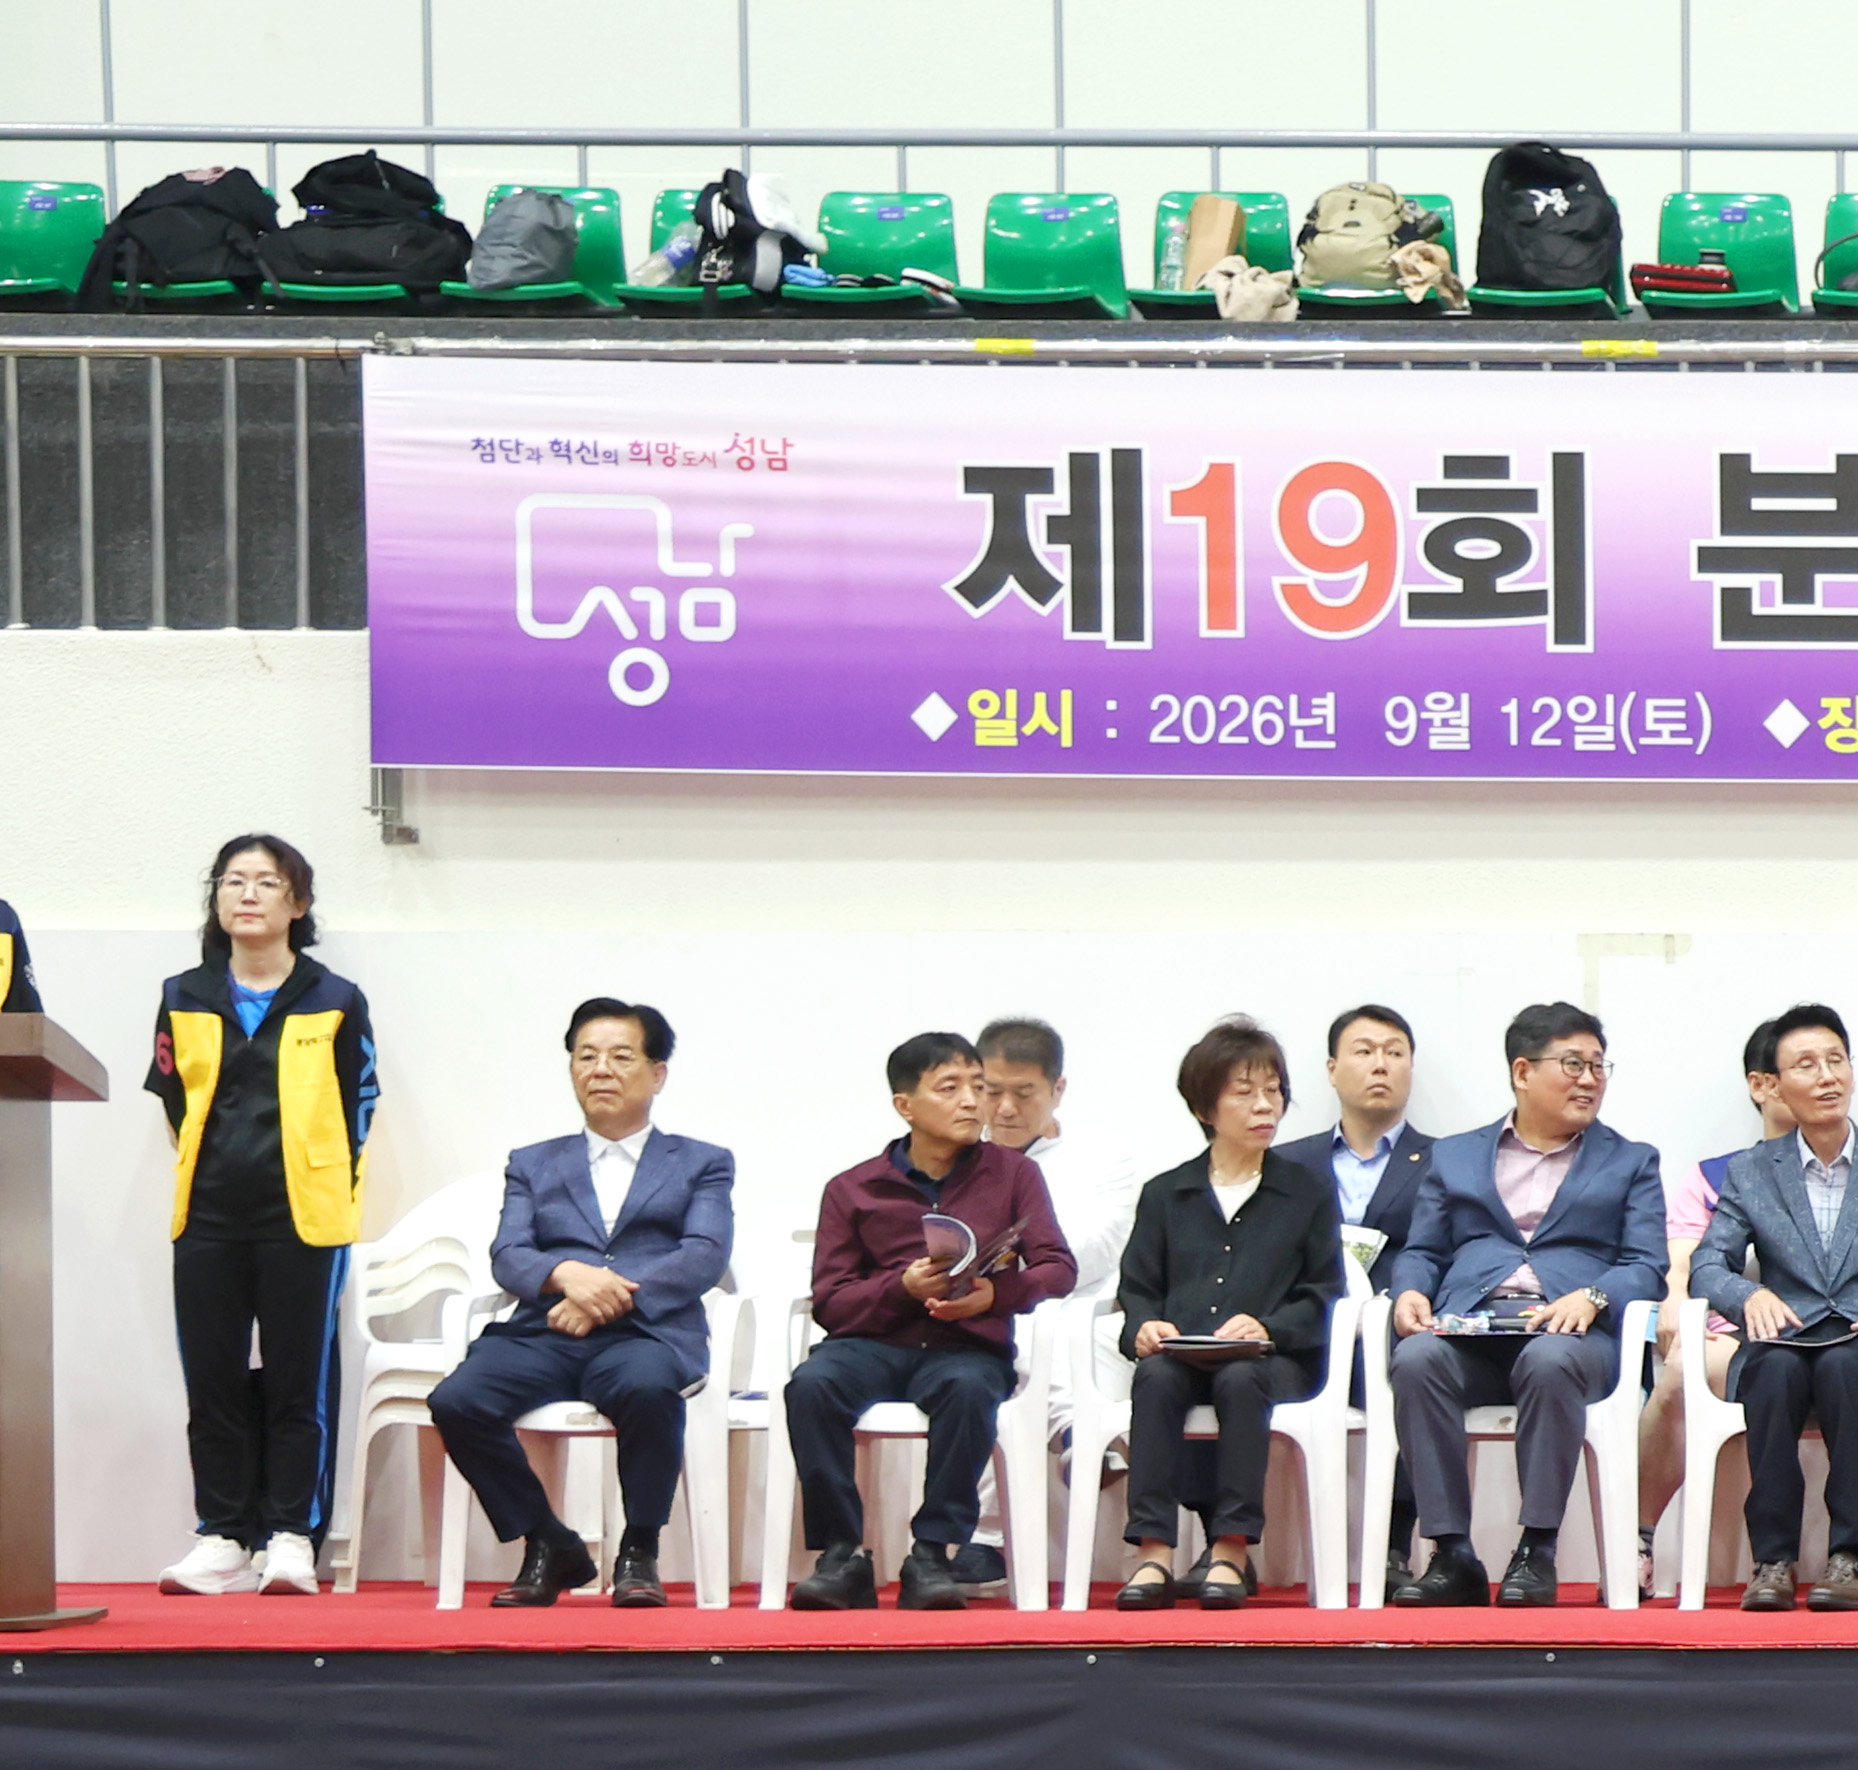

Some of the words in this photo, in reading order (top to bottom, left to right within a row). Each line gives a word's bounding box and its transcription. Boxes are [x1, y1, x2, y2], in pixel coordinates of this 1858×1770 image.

[471, 437, 543, 465] 첨단과
[549, 437, 619, 466] 혁신의
[627, 440, 718, 469] 희망도시
[723, 432, 795, 472] 성남
[948, 445, 1590, 650] 제19회
[967, 689, 1073, 748] 일시
[1147, 692, 1340, 750] 2026년
[1382, 692, 1471, 750] 9월
[1499, 693, 1713, 757] 12일(토)
